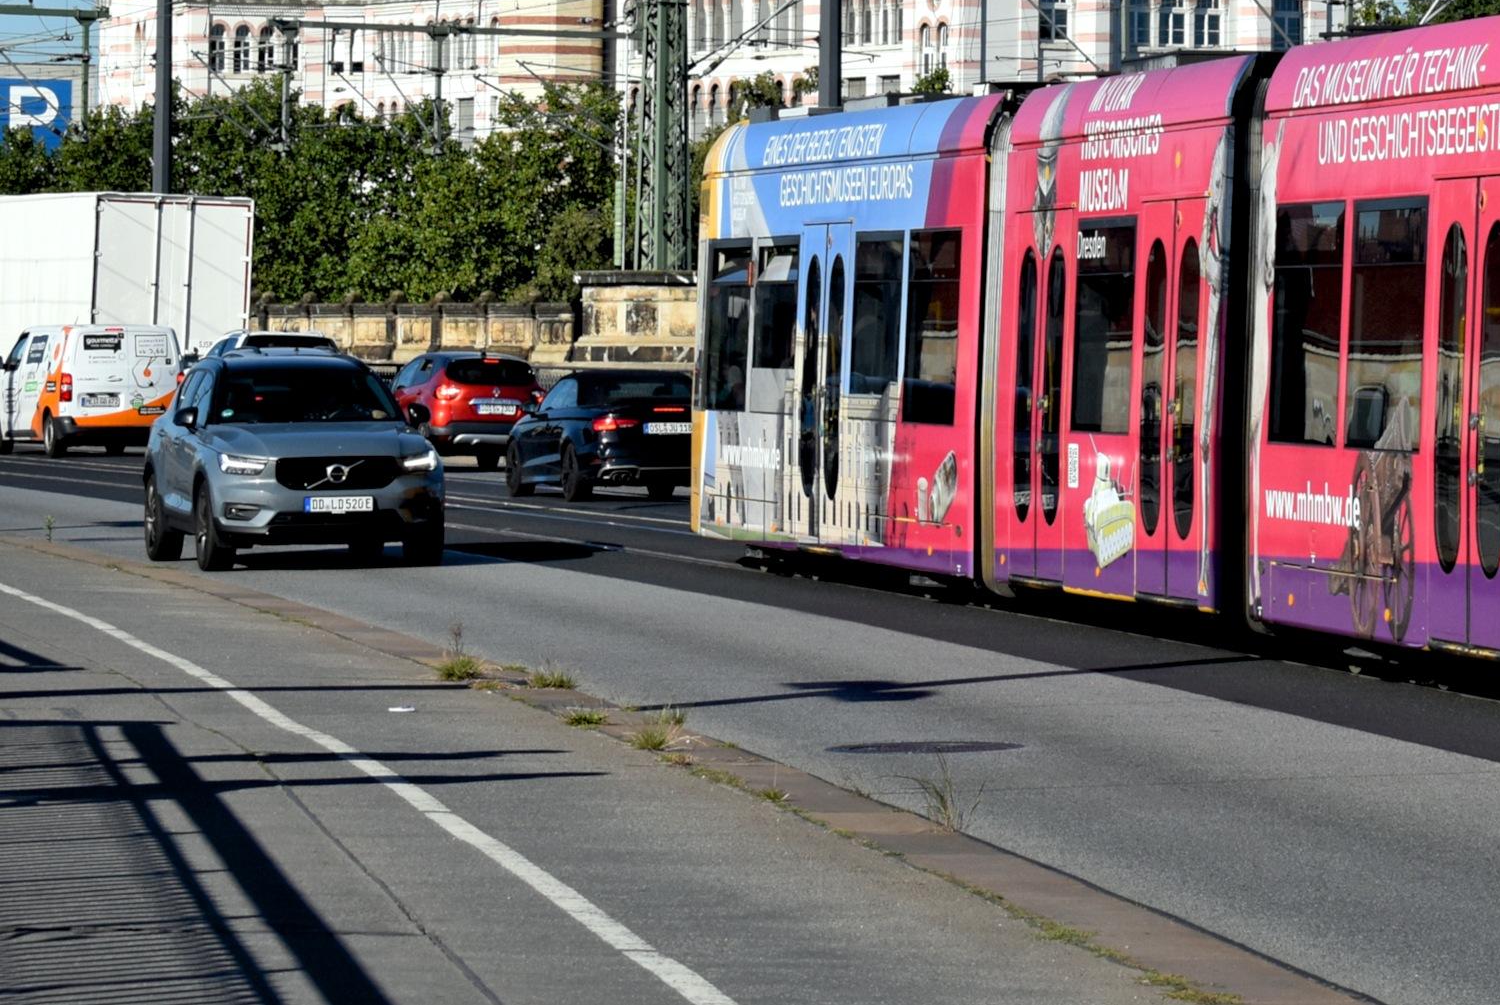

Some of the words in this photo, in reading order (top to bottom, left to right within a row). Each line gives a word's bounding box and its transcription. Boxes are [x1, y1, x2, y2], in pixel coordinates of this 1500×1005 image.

[1292, 64, 1325, 109] DAS
[1322, 56, 1389, 105] MUSEUM
[1384, 47, 1421, 98] FÜR
[1418, 44, 1489, 94] TECHNIK-
[9, 85, 60, 130] P
[763, 134, 790, 166] EINES
[787, 130, 812, 163] DER
[807, 123, 888, 161] BEDEUTENDSTEN
[1081, 113, 1164, 160] HISTORISCHES
[1318, 119, 1347, 165] UND
[780, 166, 868, 207] GESCHICHTSMUSEEN
[869, 164, 914, 201] EUROPAS
[1079, 168, 1129, 212] MUSEUM
[1077, 230, 1107, 259] Dresden
[1265, 481, 1361, 528] www.mhmbw.de
